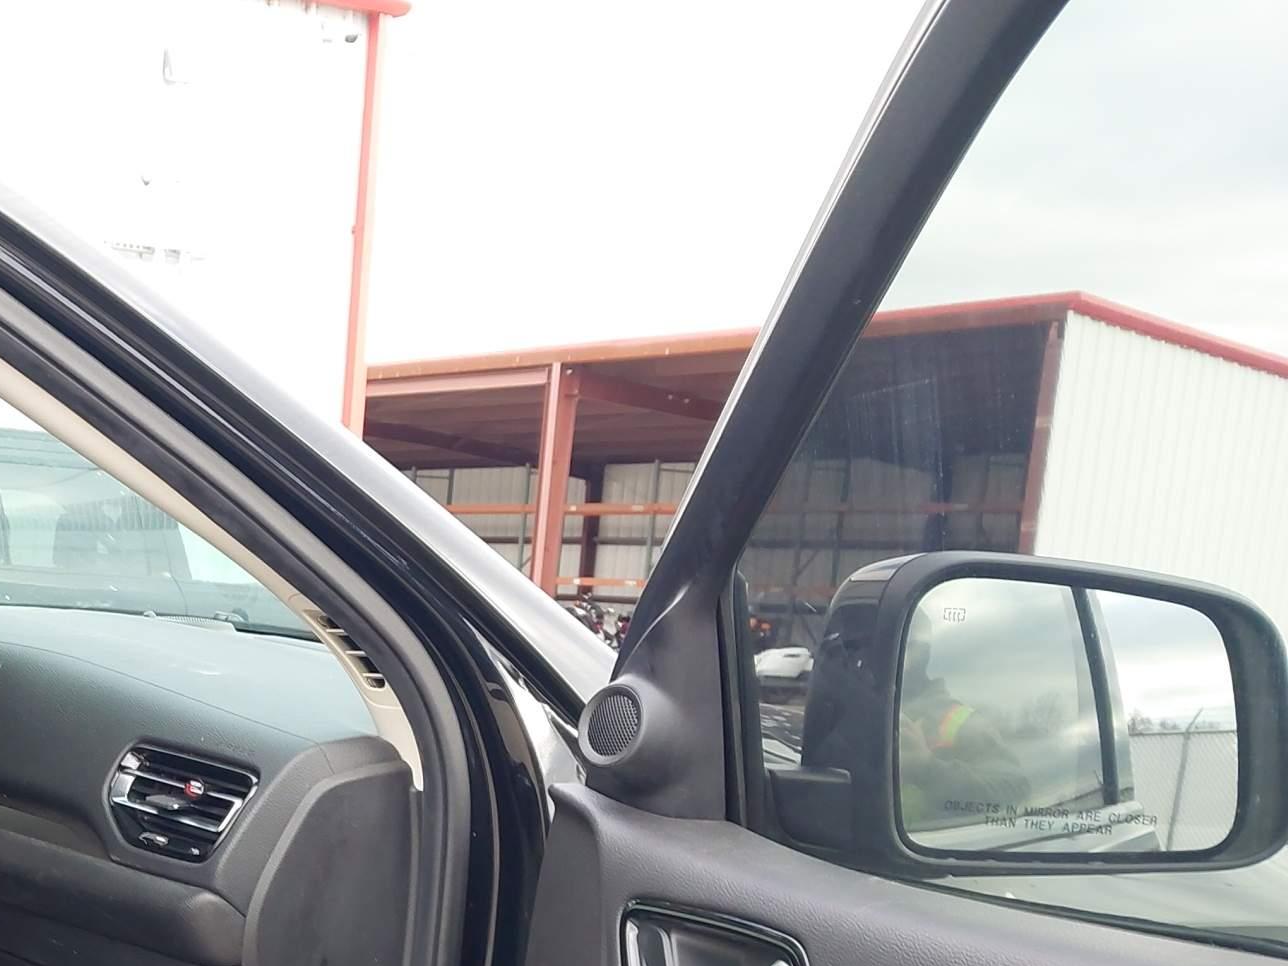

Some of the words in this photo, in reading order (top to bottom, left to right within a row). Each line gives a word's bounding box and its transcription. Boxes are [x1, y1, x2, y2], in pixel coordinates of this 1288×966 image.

[944, 800, 999, 814] OBJECTS
[1006, 804, 1018, 816] IN
[1024, 807, 1070, 819] MIRROR
[1077, 809, 1101, 822] ARE
[1109, 812, 1158, 826] CLOSER
[985, 815, 1016, 828] THAN
[1024, 819, 1055, 831] THEY
[1063, 822, 1113, 835] APPEAR
